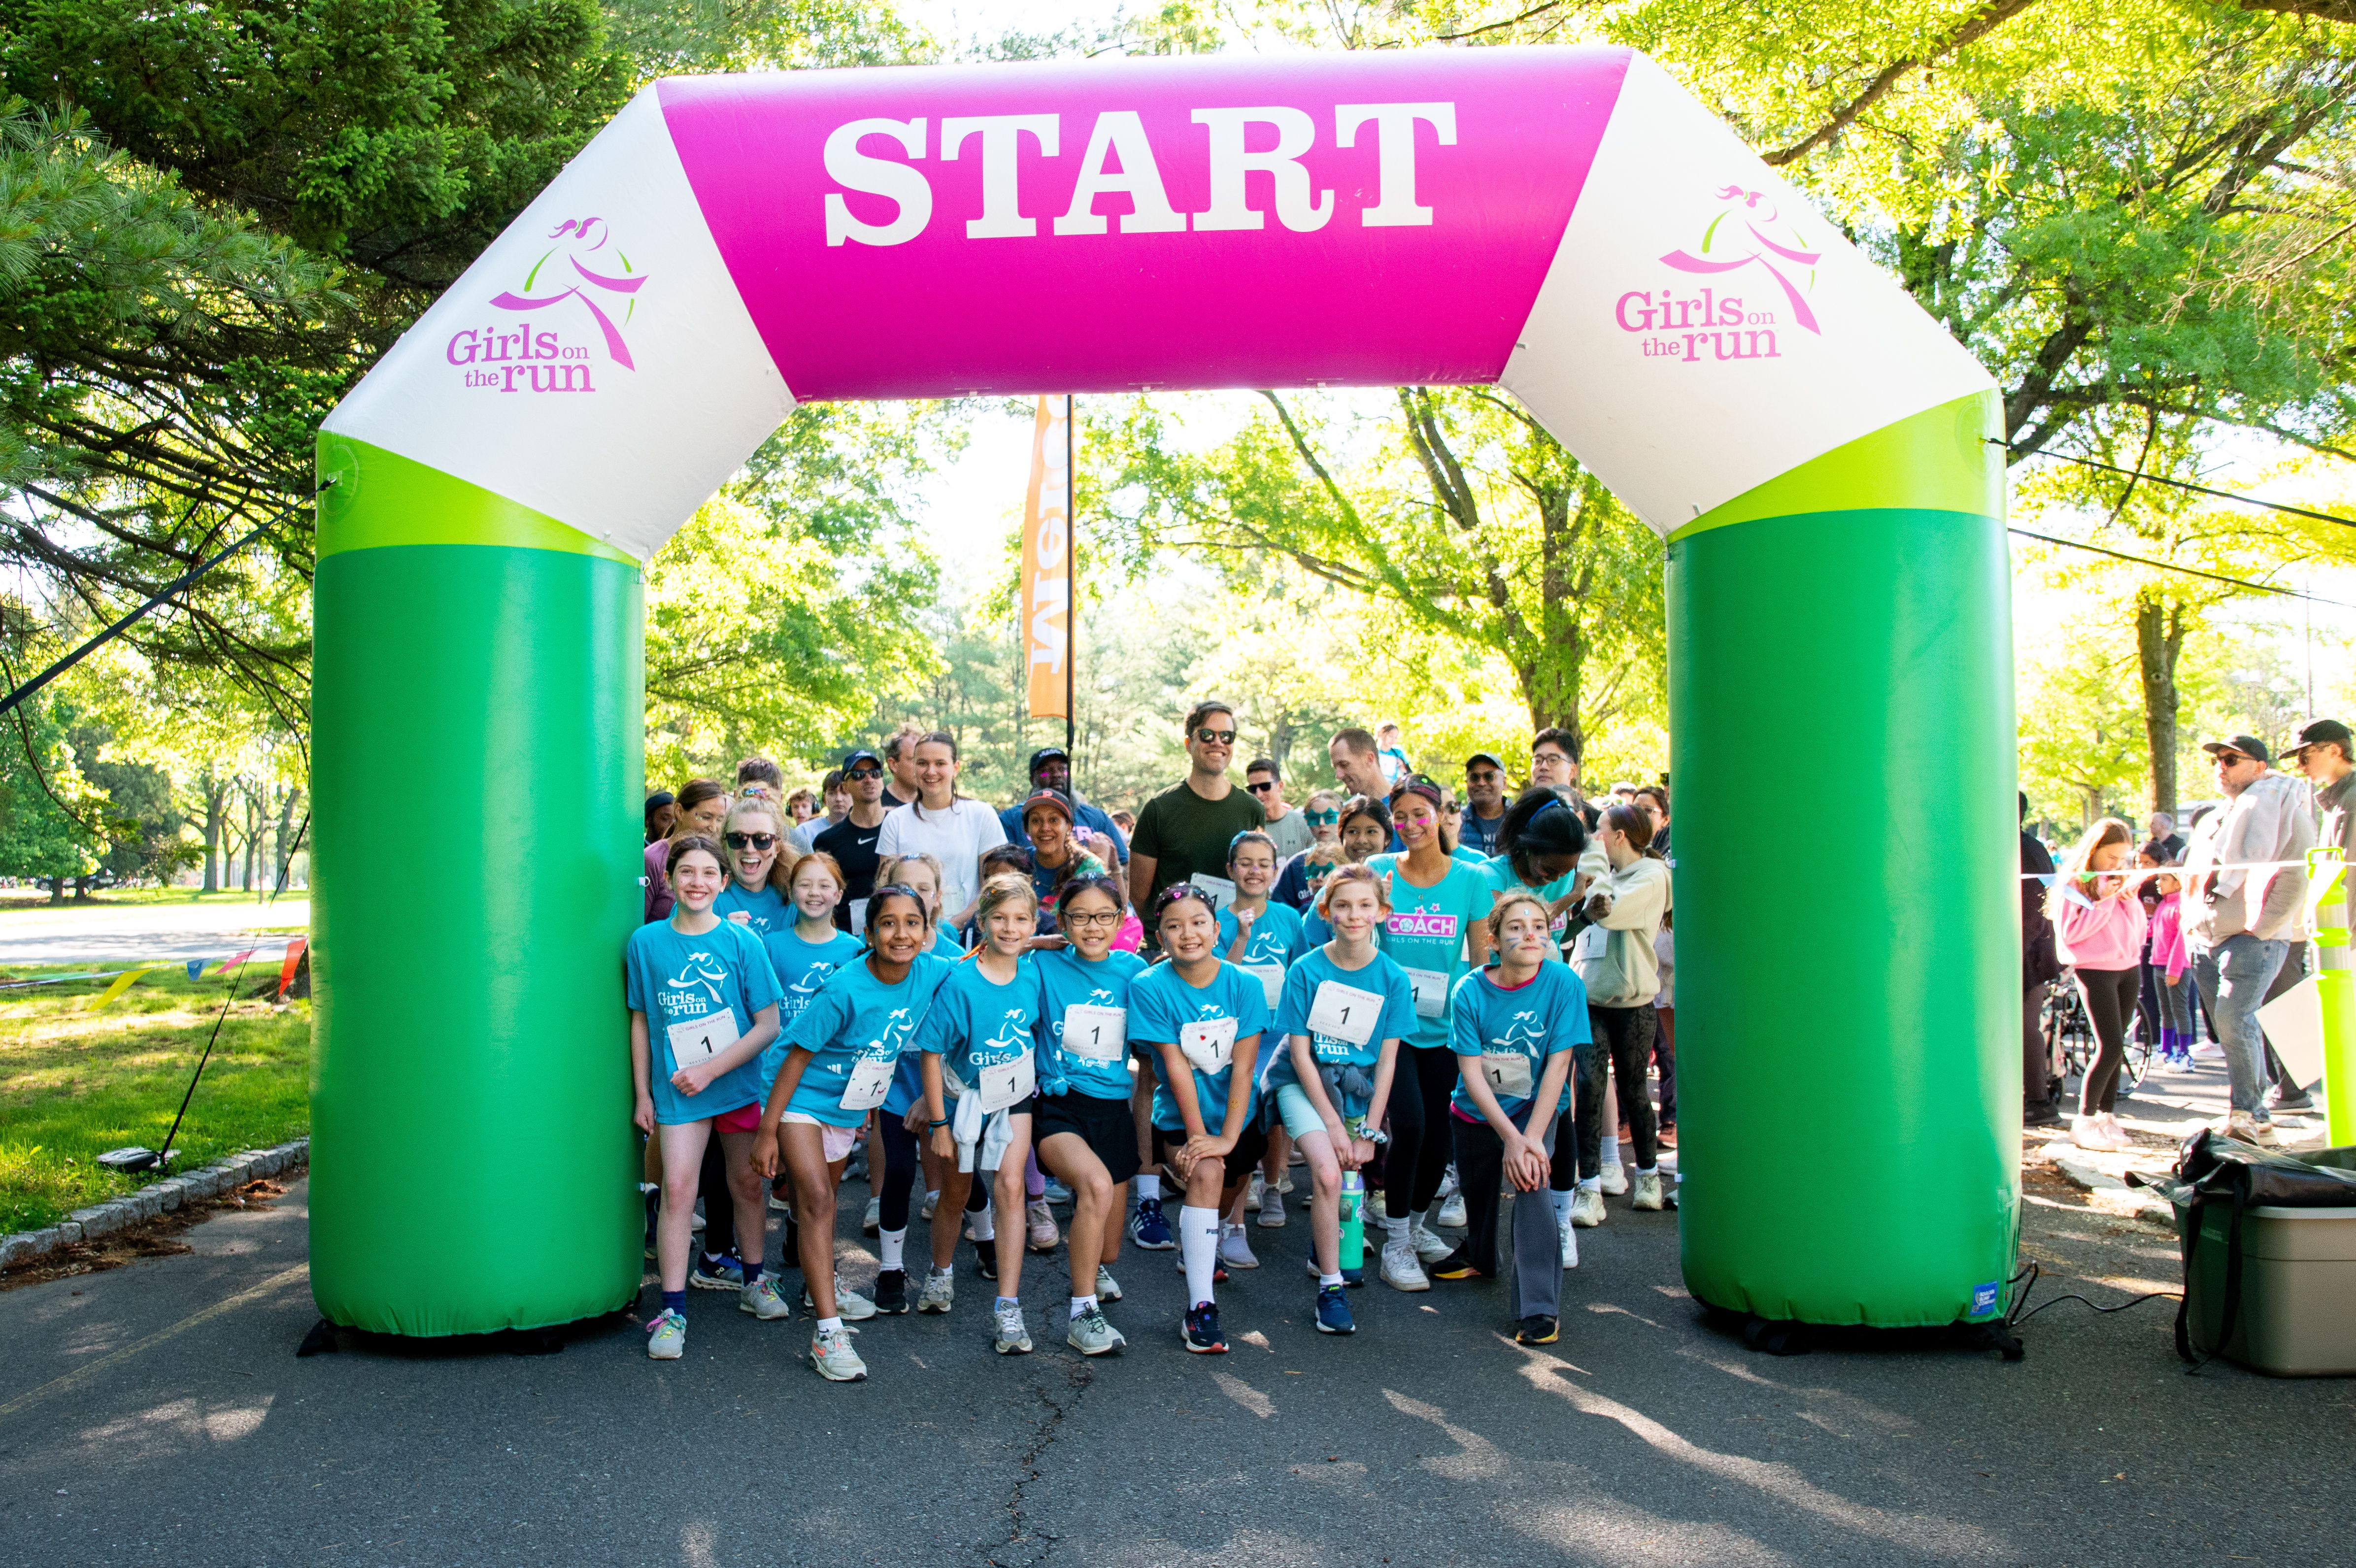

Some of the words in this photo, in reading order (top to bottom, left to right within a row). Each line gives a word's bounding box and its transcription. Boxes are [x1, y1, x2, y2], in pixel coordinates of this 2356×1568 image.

[823, 102, 1457, 247] START
[1615, 288, 1744, 333] Girls
[1747, 312, 1776, 325] on
[447, 323, 559, 366] Girls
[562, 346, 590, 360] on
[1641, 338, 1681, 357] the
[1681, 329, 1782, 363] run
[464, 369, 500, 388] the
[500, 364, 596, 393] run
[1387, 917, 1454, 934] COACH
[1586, 933, 1591, 948] 1
[658, 991, 695, 1006] Girls
[1411, 986, 1419, 1002] 1
[673, 1002, 708, 1016] run
[1341, 1006, 1350, 1025] 1
[701, 1035, 712, 1054] 1
[1091, 1026, 1100, 1045] 1
[1210, 1039, 1219, 1058] 1
[1317, 1043, 1349, 1056] run
[1008, 1076, 1015, 1093] 1
[1491, 1068, 1502, 1084] 1
[871, 1080, 880, 1097] 1
